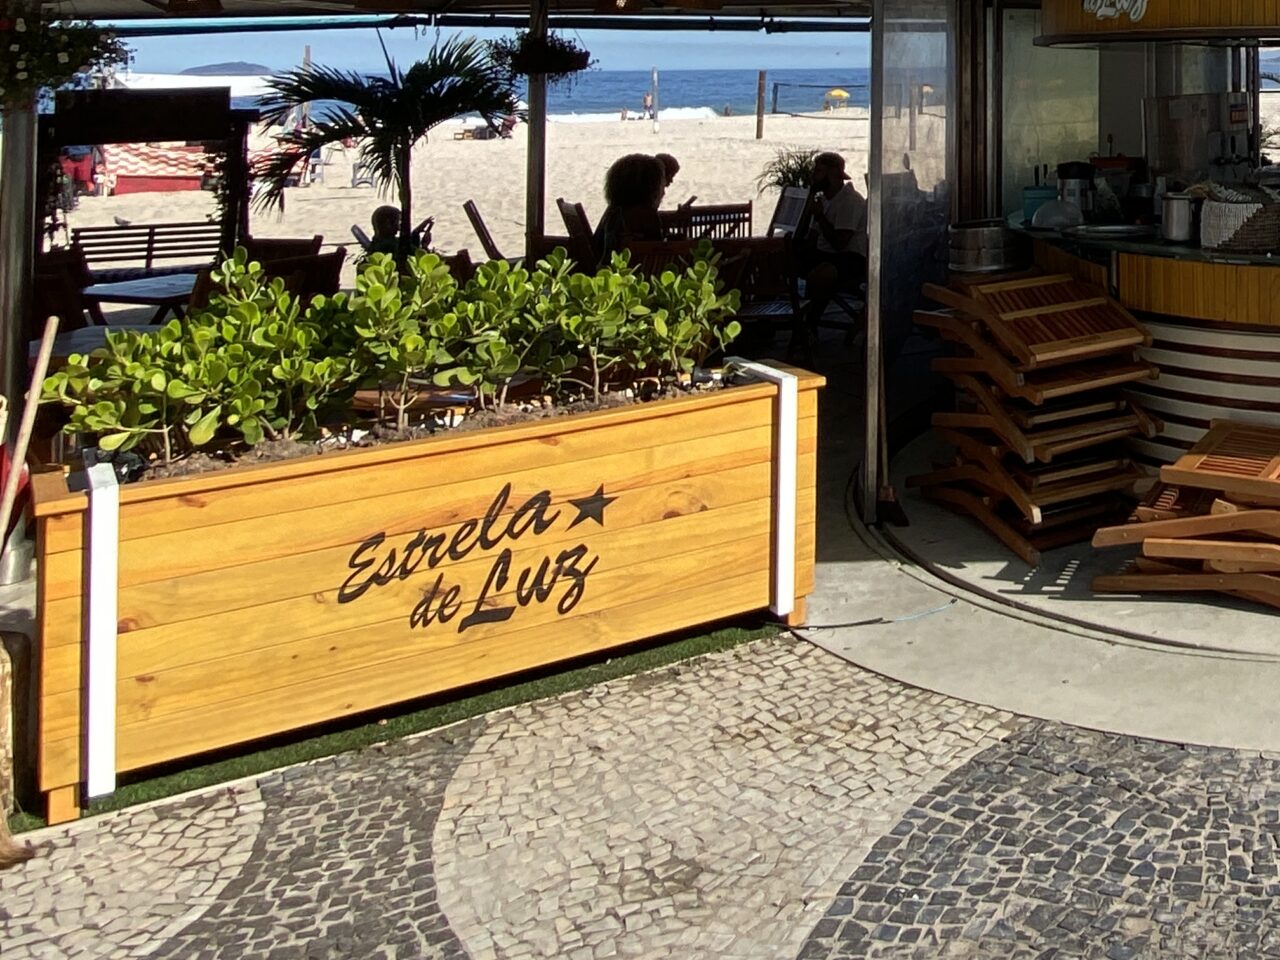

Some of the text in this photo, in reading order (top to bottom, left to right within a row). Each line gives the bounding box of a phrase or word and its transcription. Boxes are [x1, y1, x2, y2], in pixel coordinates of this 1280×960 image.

[338, 482, 561, 603] Estrela
[410, 543, 599, 633] de Luz
